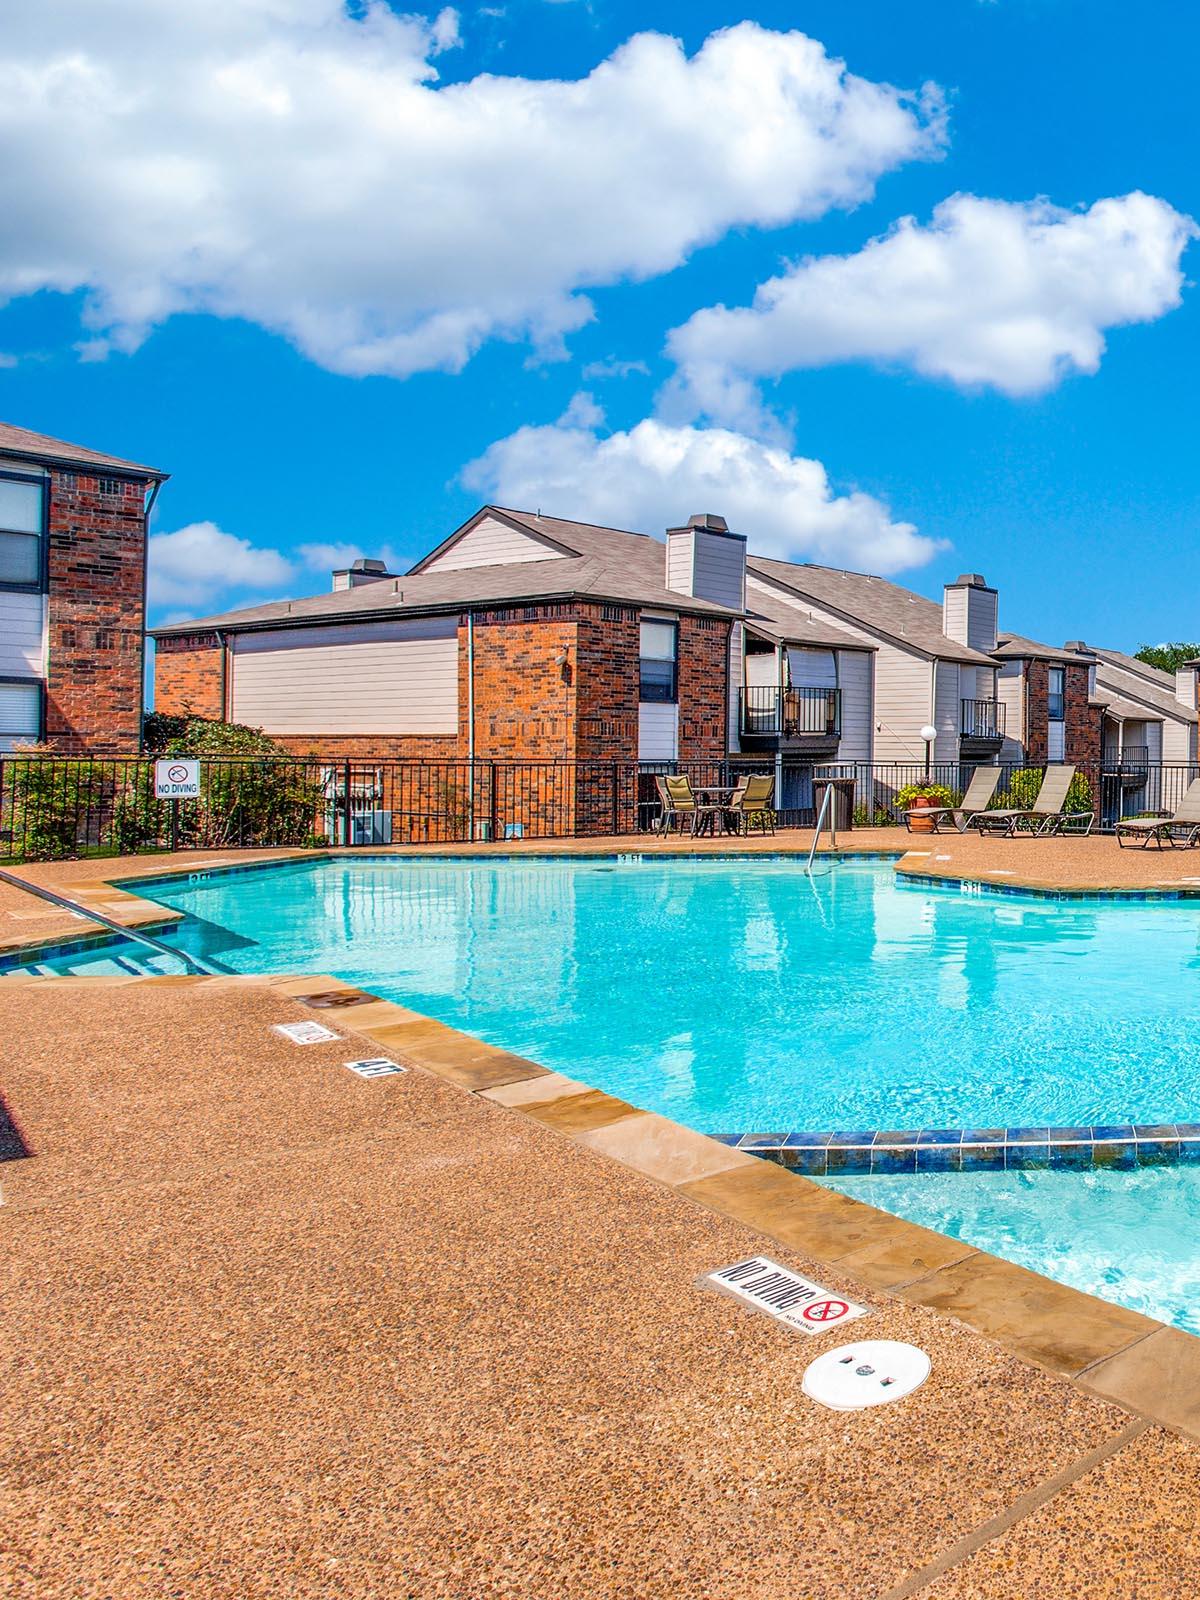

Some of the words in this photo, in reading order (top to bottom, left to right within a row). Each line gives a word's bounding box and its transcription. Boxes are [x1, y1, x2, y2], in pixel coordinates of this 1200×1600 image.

[158, 784, 170, 793] NO
[171, 783, 197, 793] DIVING
[353, 1060, 388, 1069] 4
[360, 1065, 404, 1076] FT
[717, 1260, 768, 1282] NO
[739, 1272, 817, 1311] DIVING
